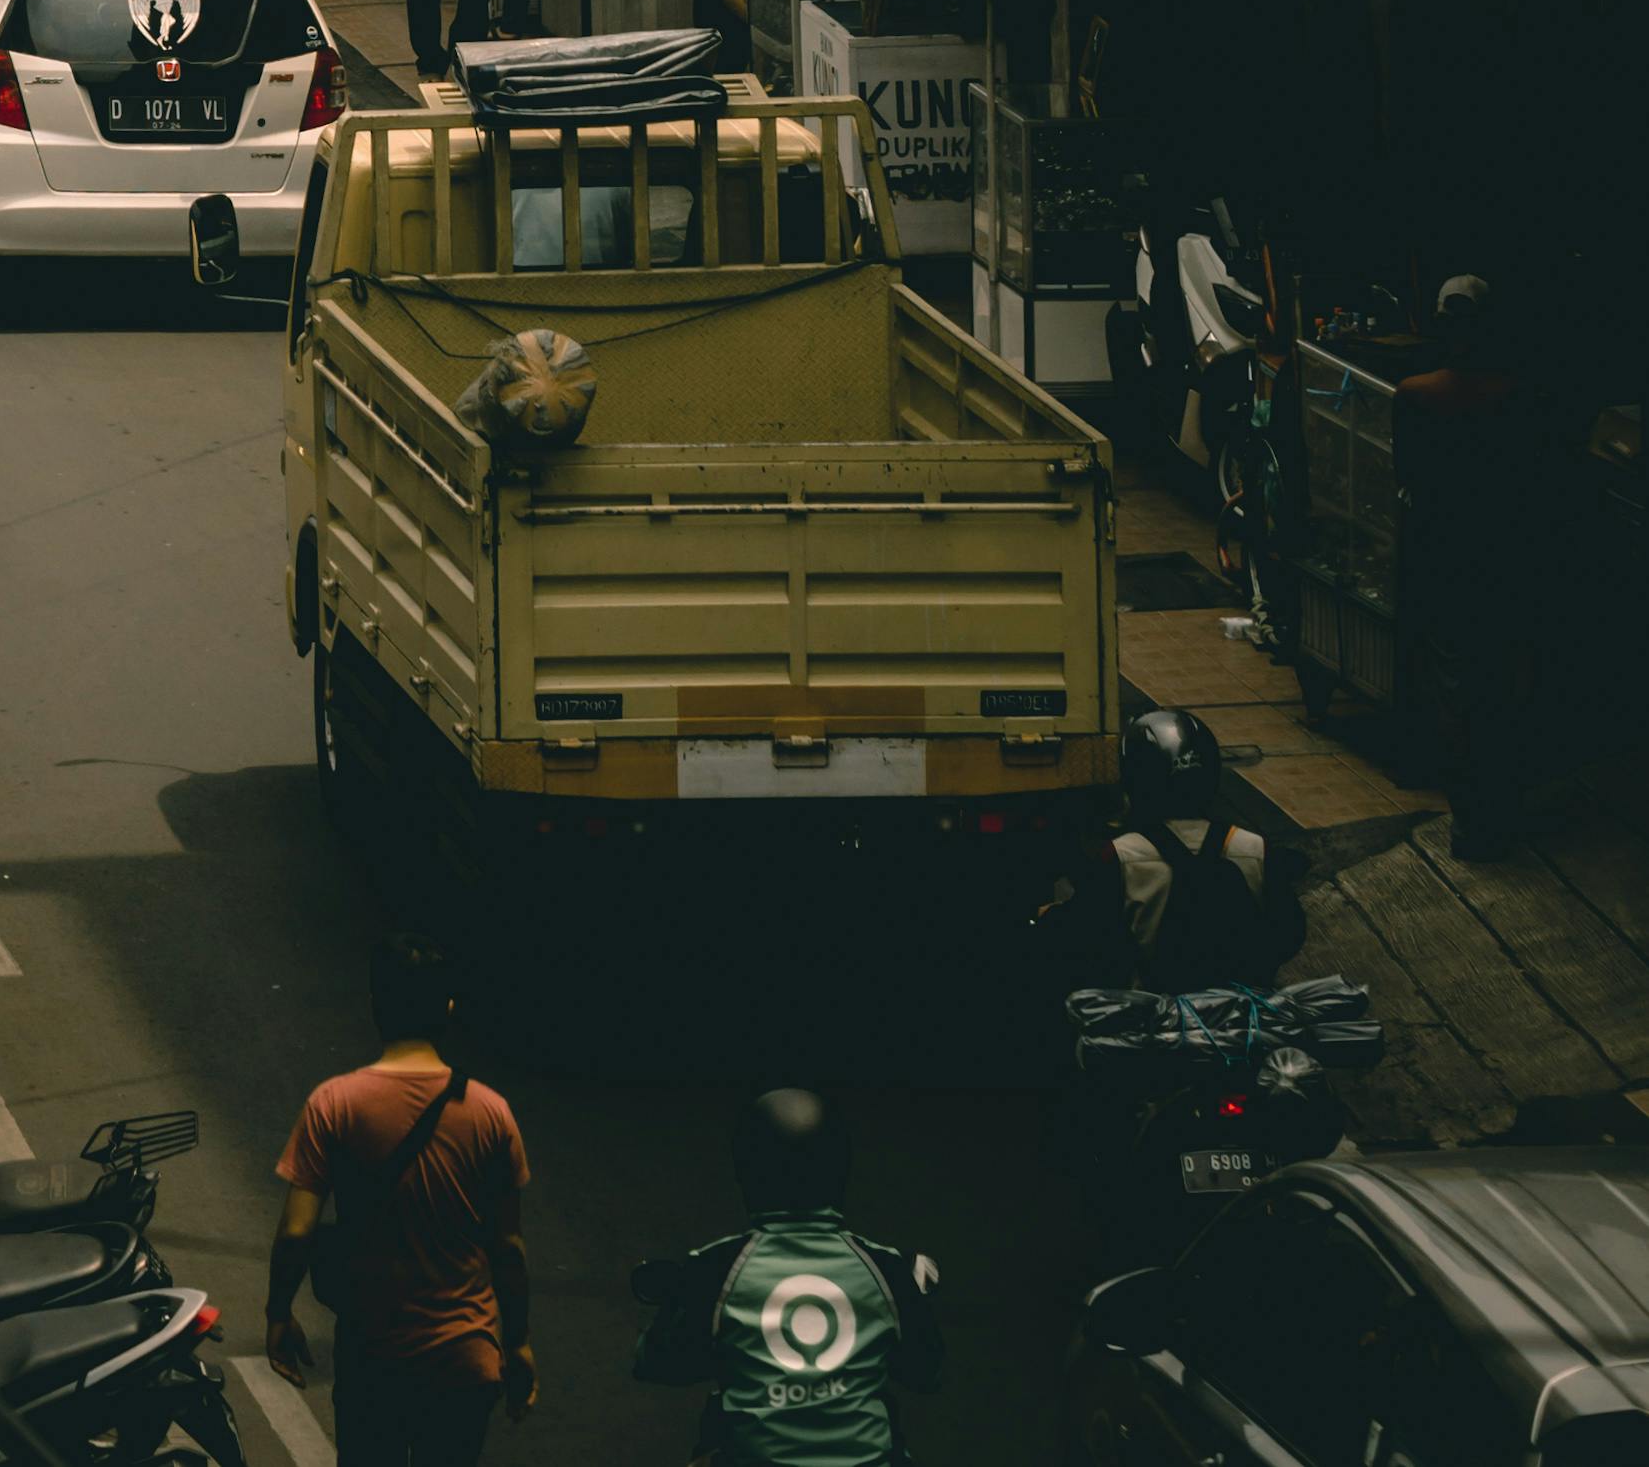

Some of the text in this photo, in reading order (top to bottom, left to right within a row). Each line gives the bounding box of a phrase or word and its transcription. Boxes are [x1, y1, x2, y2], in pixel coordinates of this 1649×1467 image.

[111, 99, 224, 121] D 1071 VL
[858, 77, 986, 131] KUNC
[1183, 1153, 1252, 1173] D 6908
